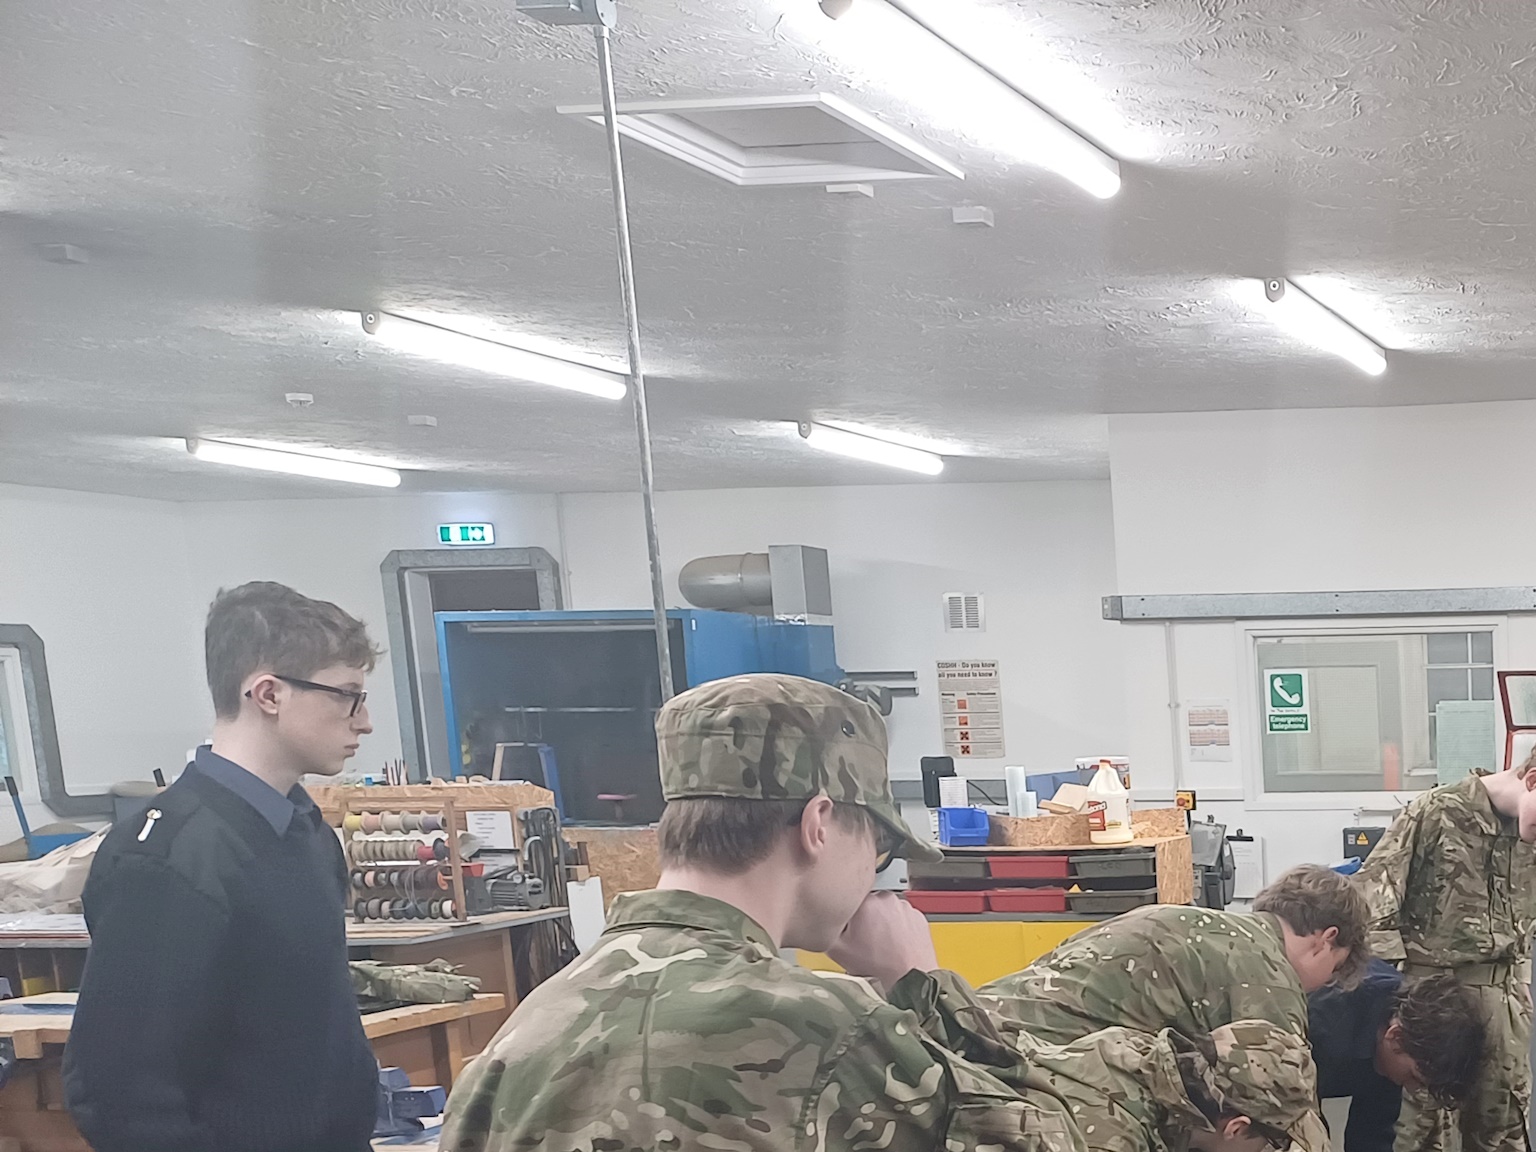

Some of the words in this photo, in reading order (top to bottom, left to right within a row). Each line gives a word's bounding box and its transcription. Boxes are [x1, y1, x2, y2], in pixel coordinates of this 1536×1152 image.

[962, 661, 970, 669] Do
[1270, 716, 1307, 725] Emergency
[1272, 722, 1306, 730] telephone
